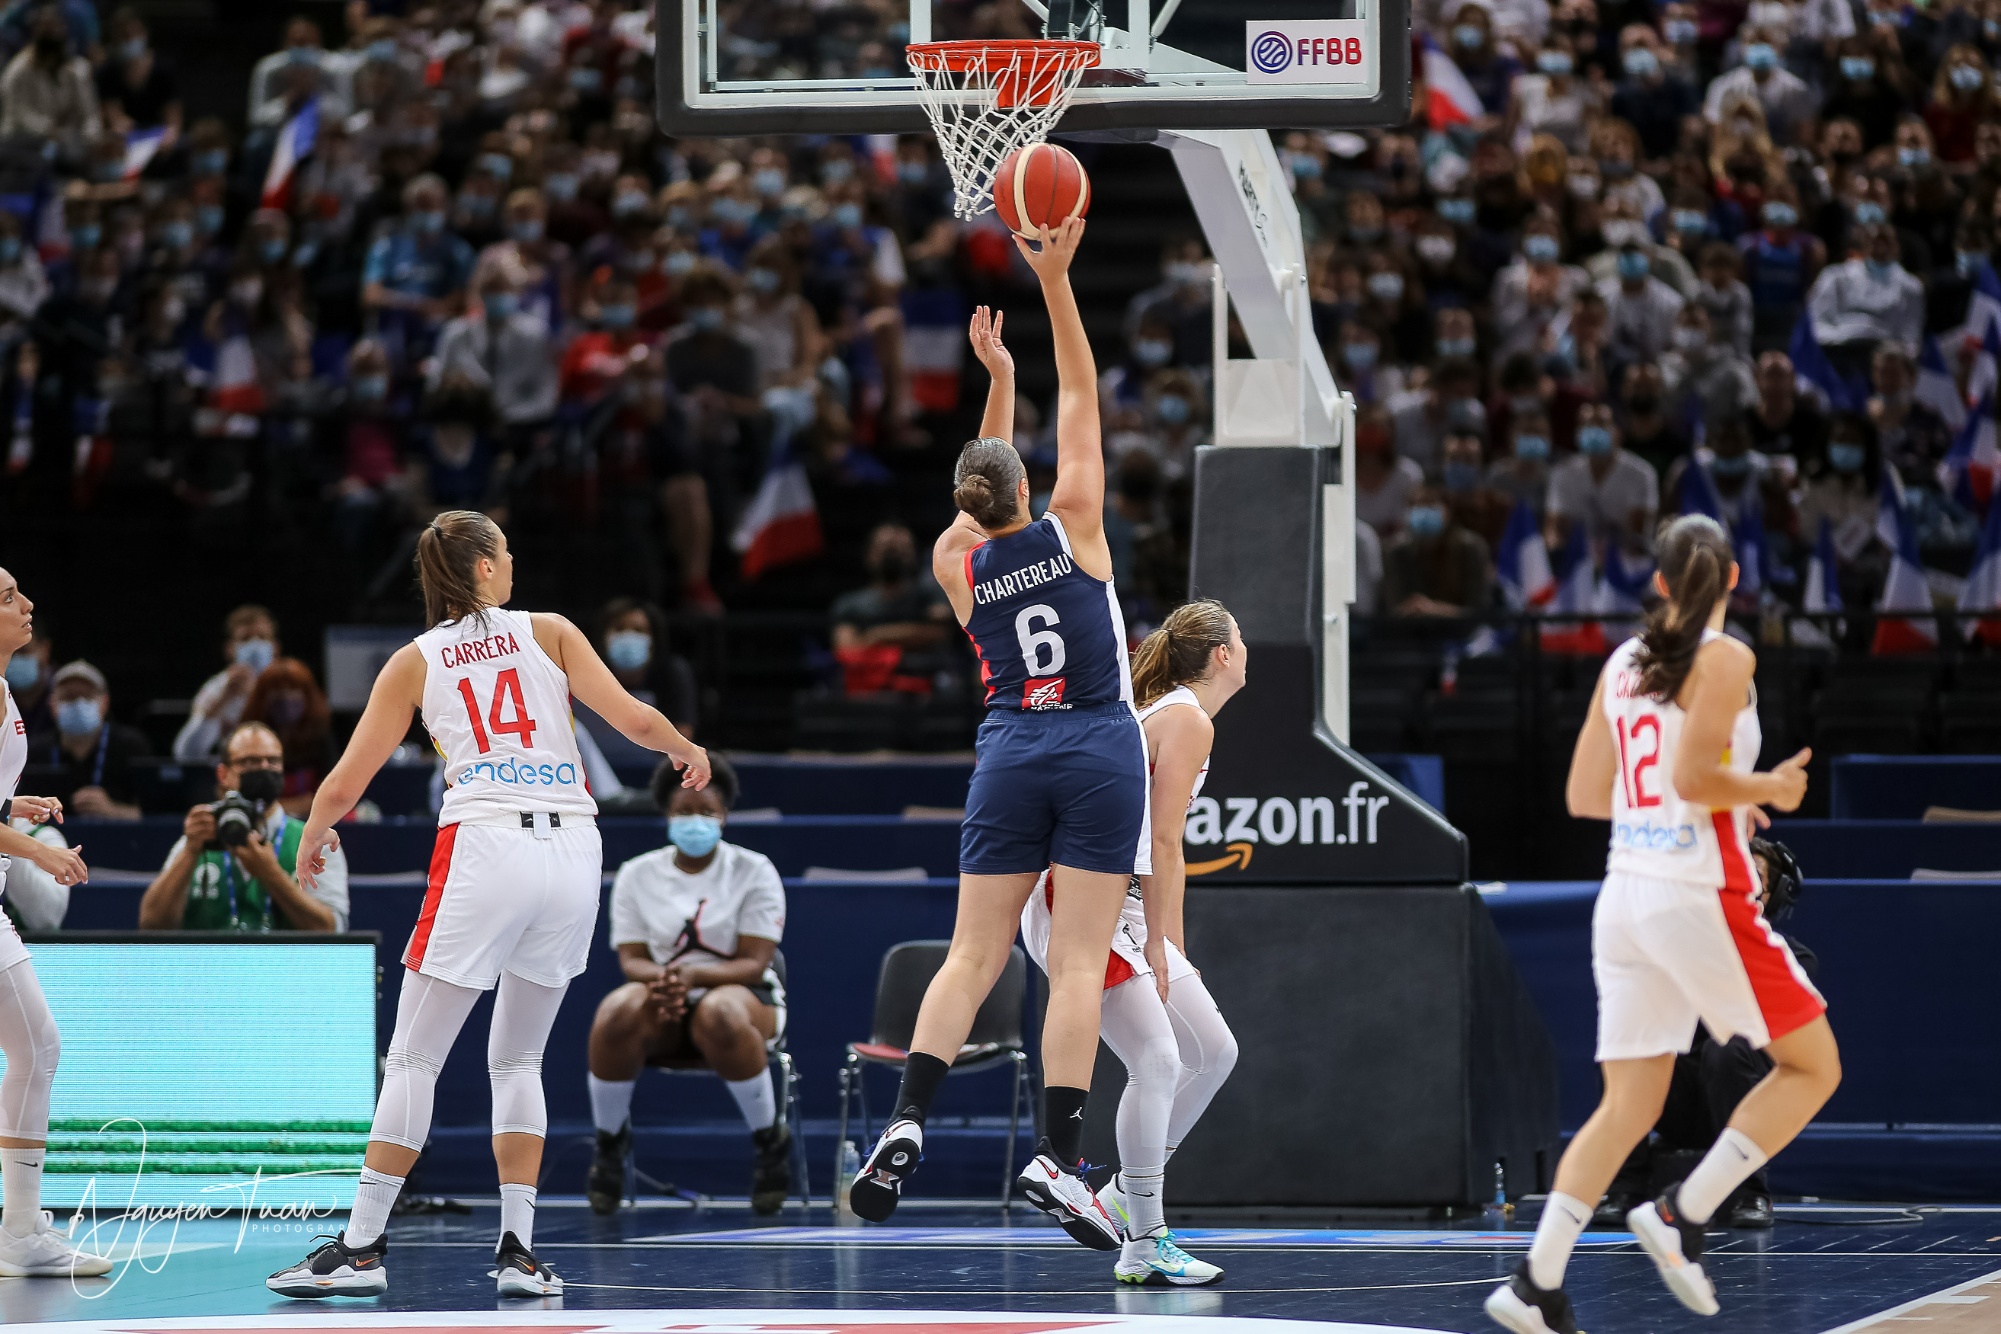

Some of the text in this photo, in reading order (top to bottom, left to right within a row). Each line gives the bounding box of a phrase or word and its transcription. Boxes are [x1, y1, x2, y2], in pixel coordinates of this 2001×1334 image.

[1297, 37, 1362, 65] FFBB
[974, 553, 1072, 605] CHARTEREAU
[441, 632, 520, 669] CARRERA
[1015, 604, 1066, 677] 6
[457, 667, 537, 754] 14
[458, 757, 577, 785] endesa
[1617, 713, 1663, 809] 12
[1184, 781, 1389, 845] azon.fr
[1616, 821, 1697, 849] ndesa
